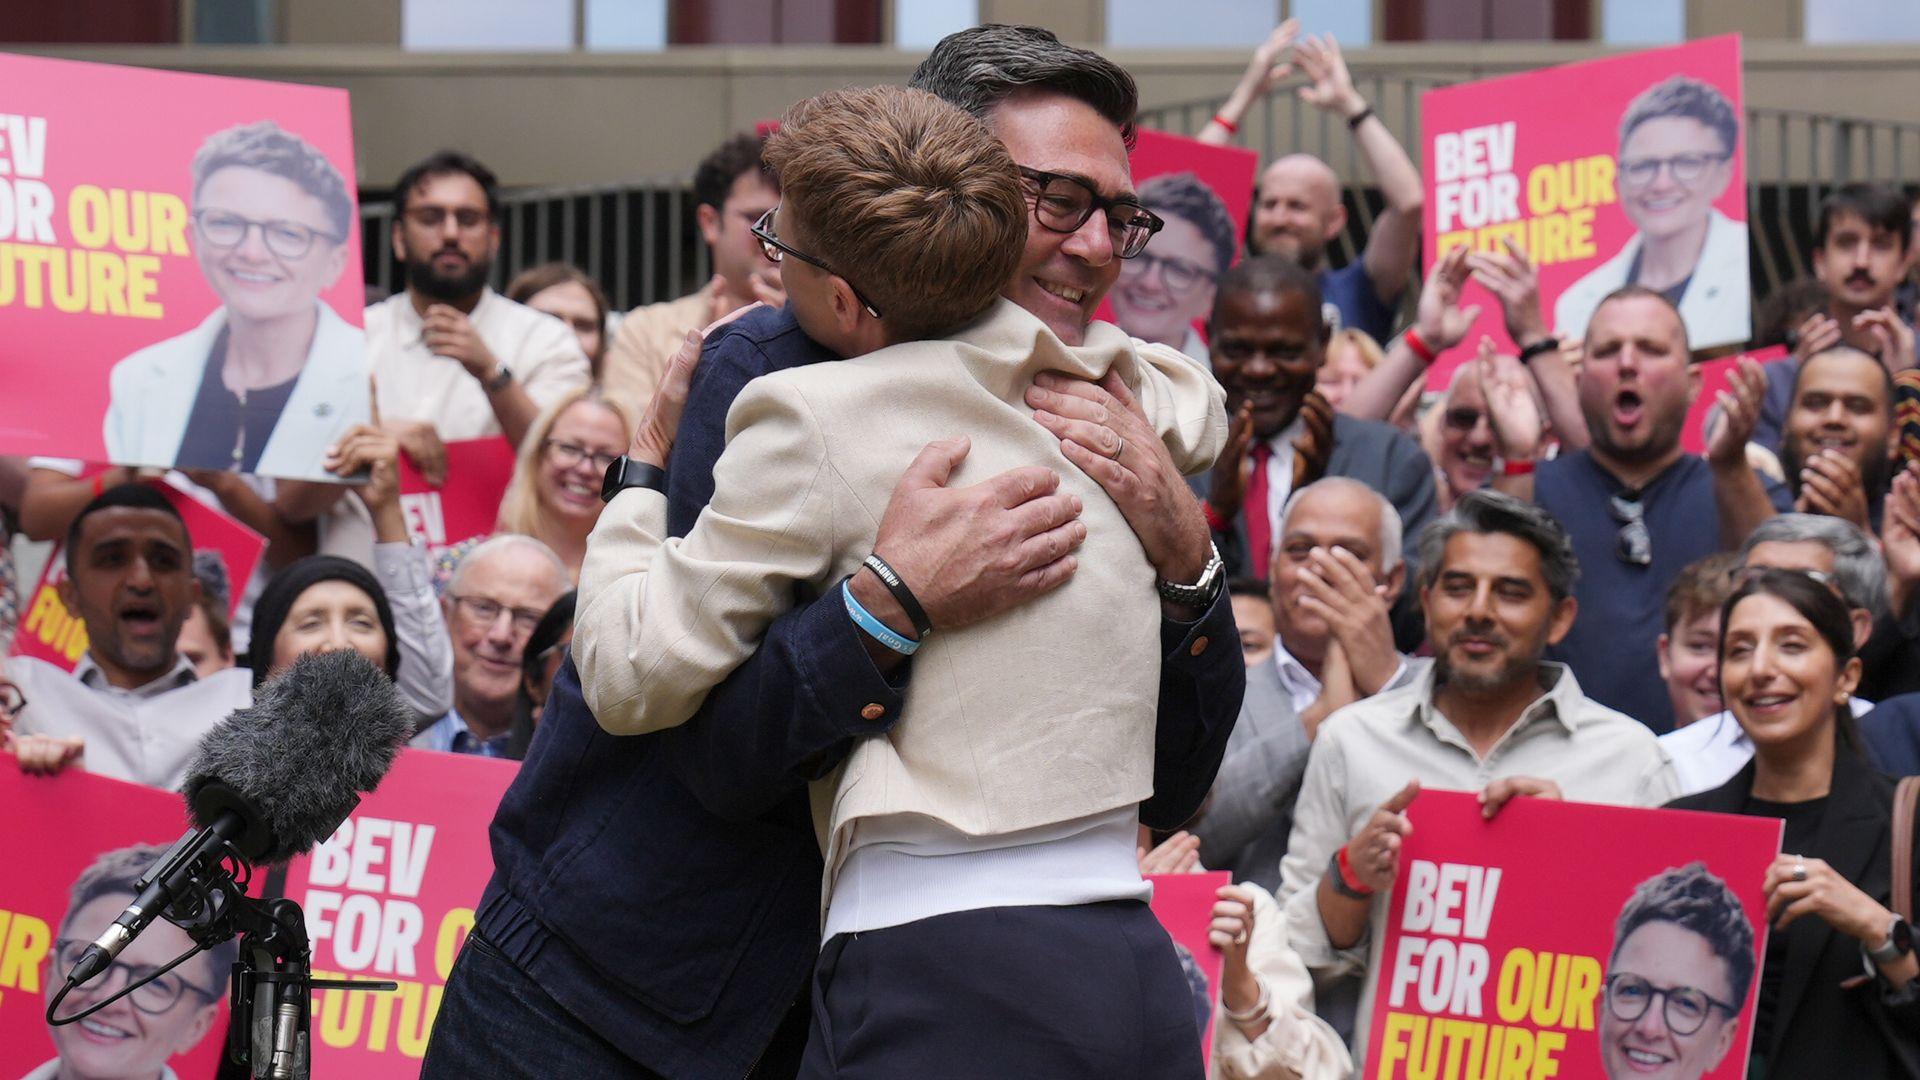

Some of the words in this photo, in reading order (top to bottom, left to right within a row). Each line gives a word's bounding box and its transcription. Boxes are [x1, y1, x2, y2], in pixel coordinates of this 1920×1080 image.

[1435, 121, 1516, 182] BEV
[67, 184, 191, 256] OUR
[1436, 172, 1520, 232] FOR
[1527, 154, 1616, 217] OUR
[308, 816, 436, 897] BEV
[303, 889, 424, 977] FOR
[1402, 859, 1502, 940] BEV
[1389, 935, 1490, 1018] FOR
[1496, 947, 1602, 1031] OUR
[1377, 1011, 1567, 1080] FUTURE
